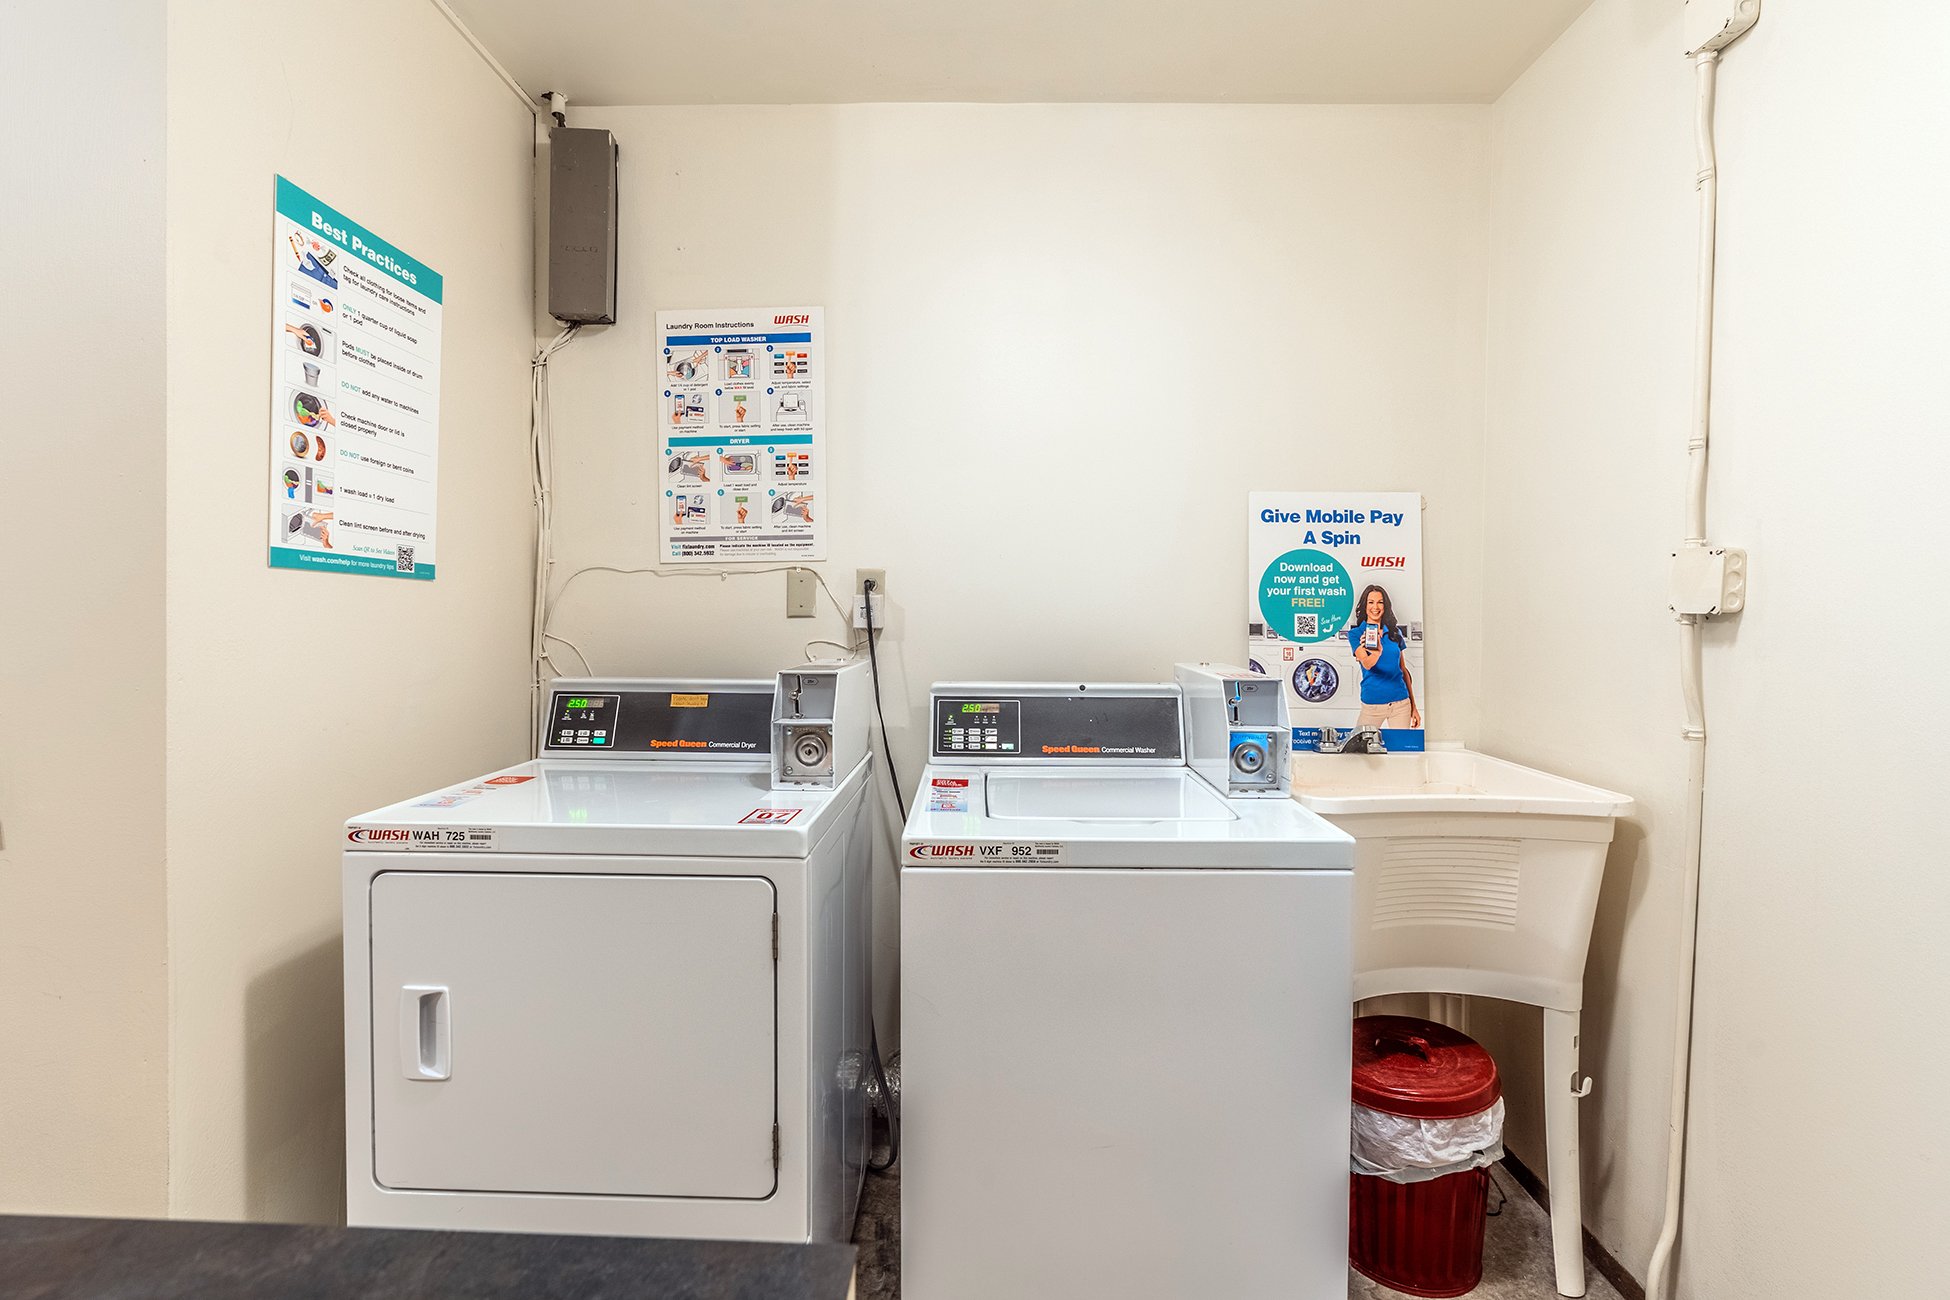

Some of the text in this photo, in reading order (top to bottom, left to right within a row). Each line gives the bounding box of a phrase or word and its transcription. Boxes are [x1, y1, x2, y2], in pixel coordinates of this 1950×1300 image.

[312, 211, 417, 285] Best Practices
[343, 266, 359, 277] Check
[367, 279, 385, 293] clothing
[360, 283, 378, 297] laundry
[379, 294, 388, 302] care
[390, 298, 415, 316] instructions
[343, 303, 356, 314] ONLY
[362, 314, 378, 325] quarter
[379, 322, 388, 330] cup
[394, 329, 406, 338] liquid
[407, 336, 417, 344] soap
[353, 318, 363, 326] pod
[774, 315, 809, 324] WASH
[342, 349, 376, 368] before clothes
[342, 340, 354, 350] Pods
[355, 346, 369, 356] MUST
[377, 356, 392, 366] placed
[393, 362, 406, 372] inside
[412, 371, 423, 379] drum
[372, 393, 380, 401] any
[399, 403, 419, 414] machines
[341, 411, 356, 421] Check
[357, 417, 376, 428] machine
[340, 420, 377, 437] closed properly
[370, 458, 386, 467] foreign
[1261, 509, 1404, 526] Give Mobile Pay
[412, 532, 425, 540] drying
[1303, 530, 1361, 547] A Spin
[312, 556, 351, 566] wash.com/help
[1361, 557, 1405, 567] WASH
[1280, 563, 1333, 572] Download
[1299, 575, 1319, 584] and
[1322, 575, 1339, 586] get
[1266, 587, 1346, 597] your first wash
[1291, 598, 1325, 608] FREE!
[650, 740, 757, 750] Speed Queen Commercial Dryer
[1042, 745, 1070, 754] Speed
[1071, 745, 1100, 754] Queen
[1135, 746, 1156, 754] Washer
[368, 830, 466, 841] WASH WAH 725
[932, 846, 1032, 856] WASH VXF 952
